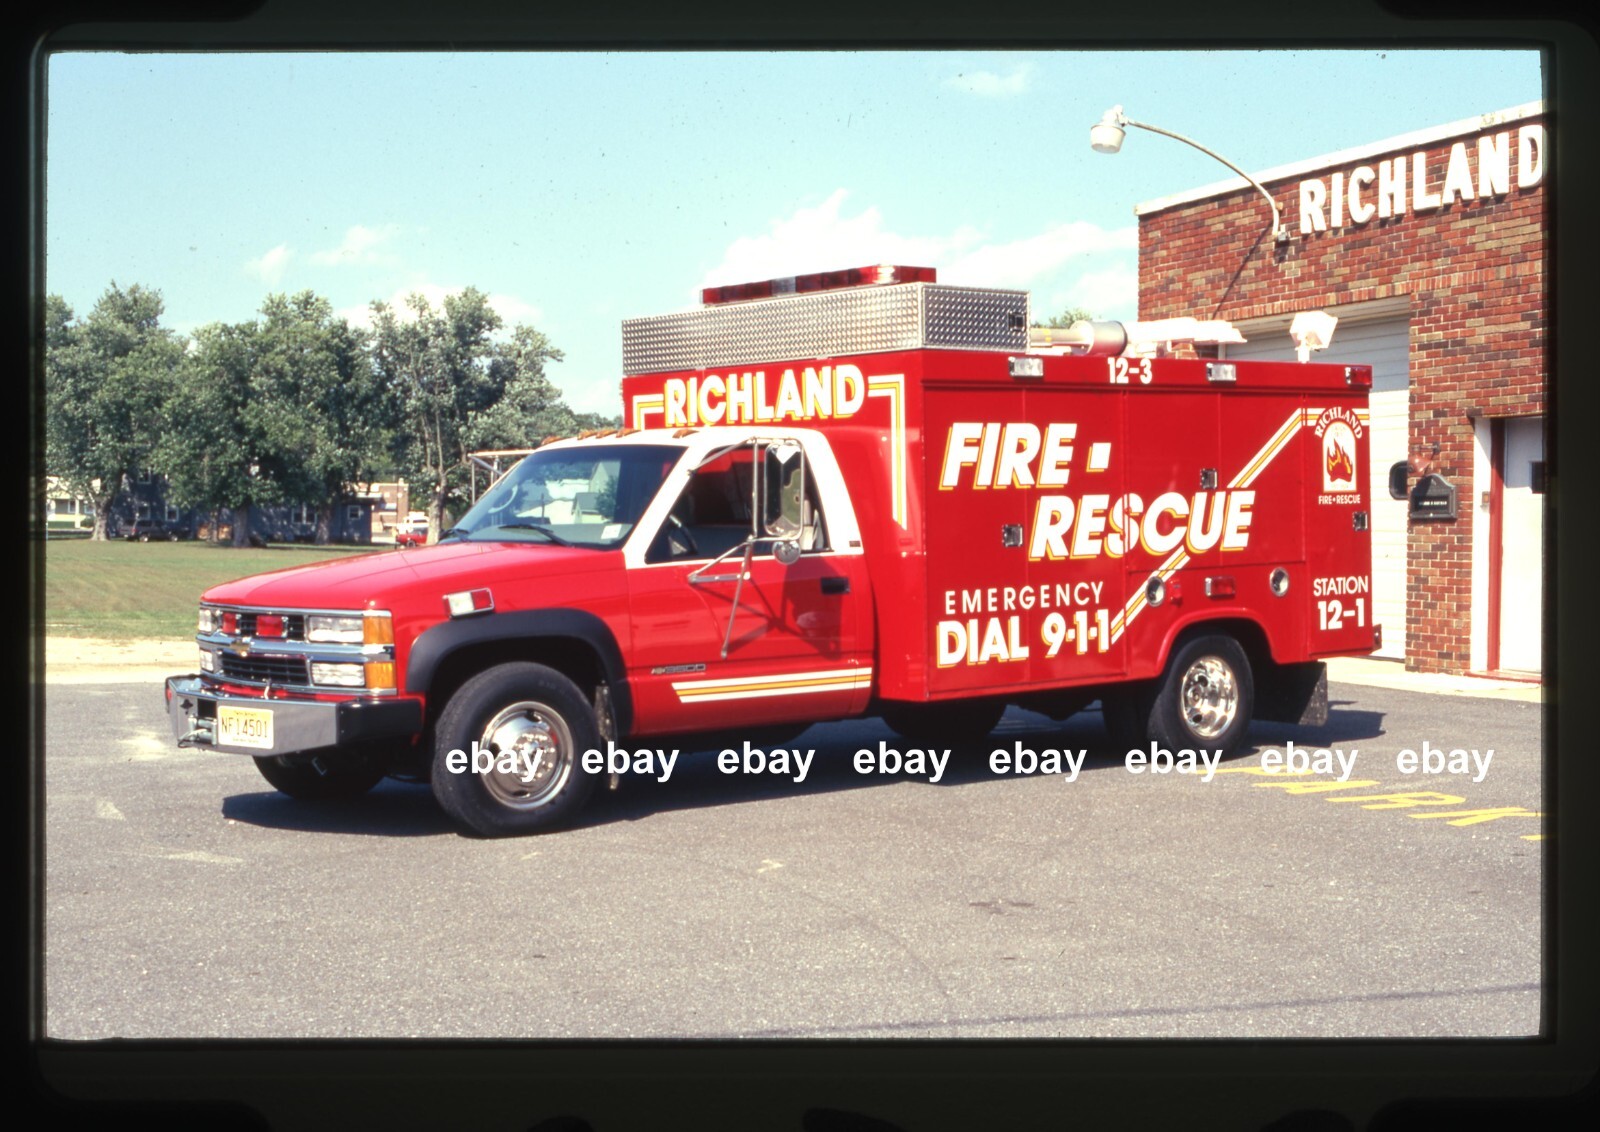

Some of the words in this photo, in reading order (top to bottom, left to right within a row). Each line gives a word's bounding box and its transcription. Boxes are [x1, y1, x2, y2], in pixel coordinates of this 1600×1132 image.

[1299, 124, 1547, 235] RICHLAND
[1107, 356, 1153, 385] 12-3
[664, 364, 866, 428] RICHLAND
[1314, 406, 1363, 439] RICHLAND
[1028, 490, 1256, 562] RESCUE
[945, 581, 1104, 615] EMERGENCY
[1313, 576, 1369, 597] STATION
[1317, 598, 1366, 631] 12-1
[937, 615, 1029, 668] DIAL
